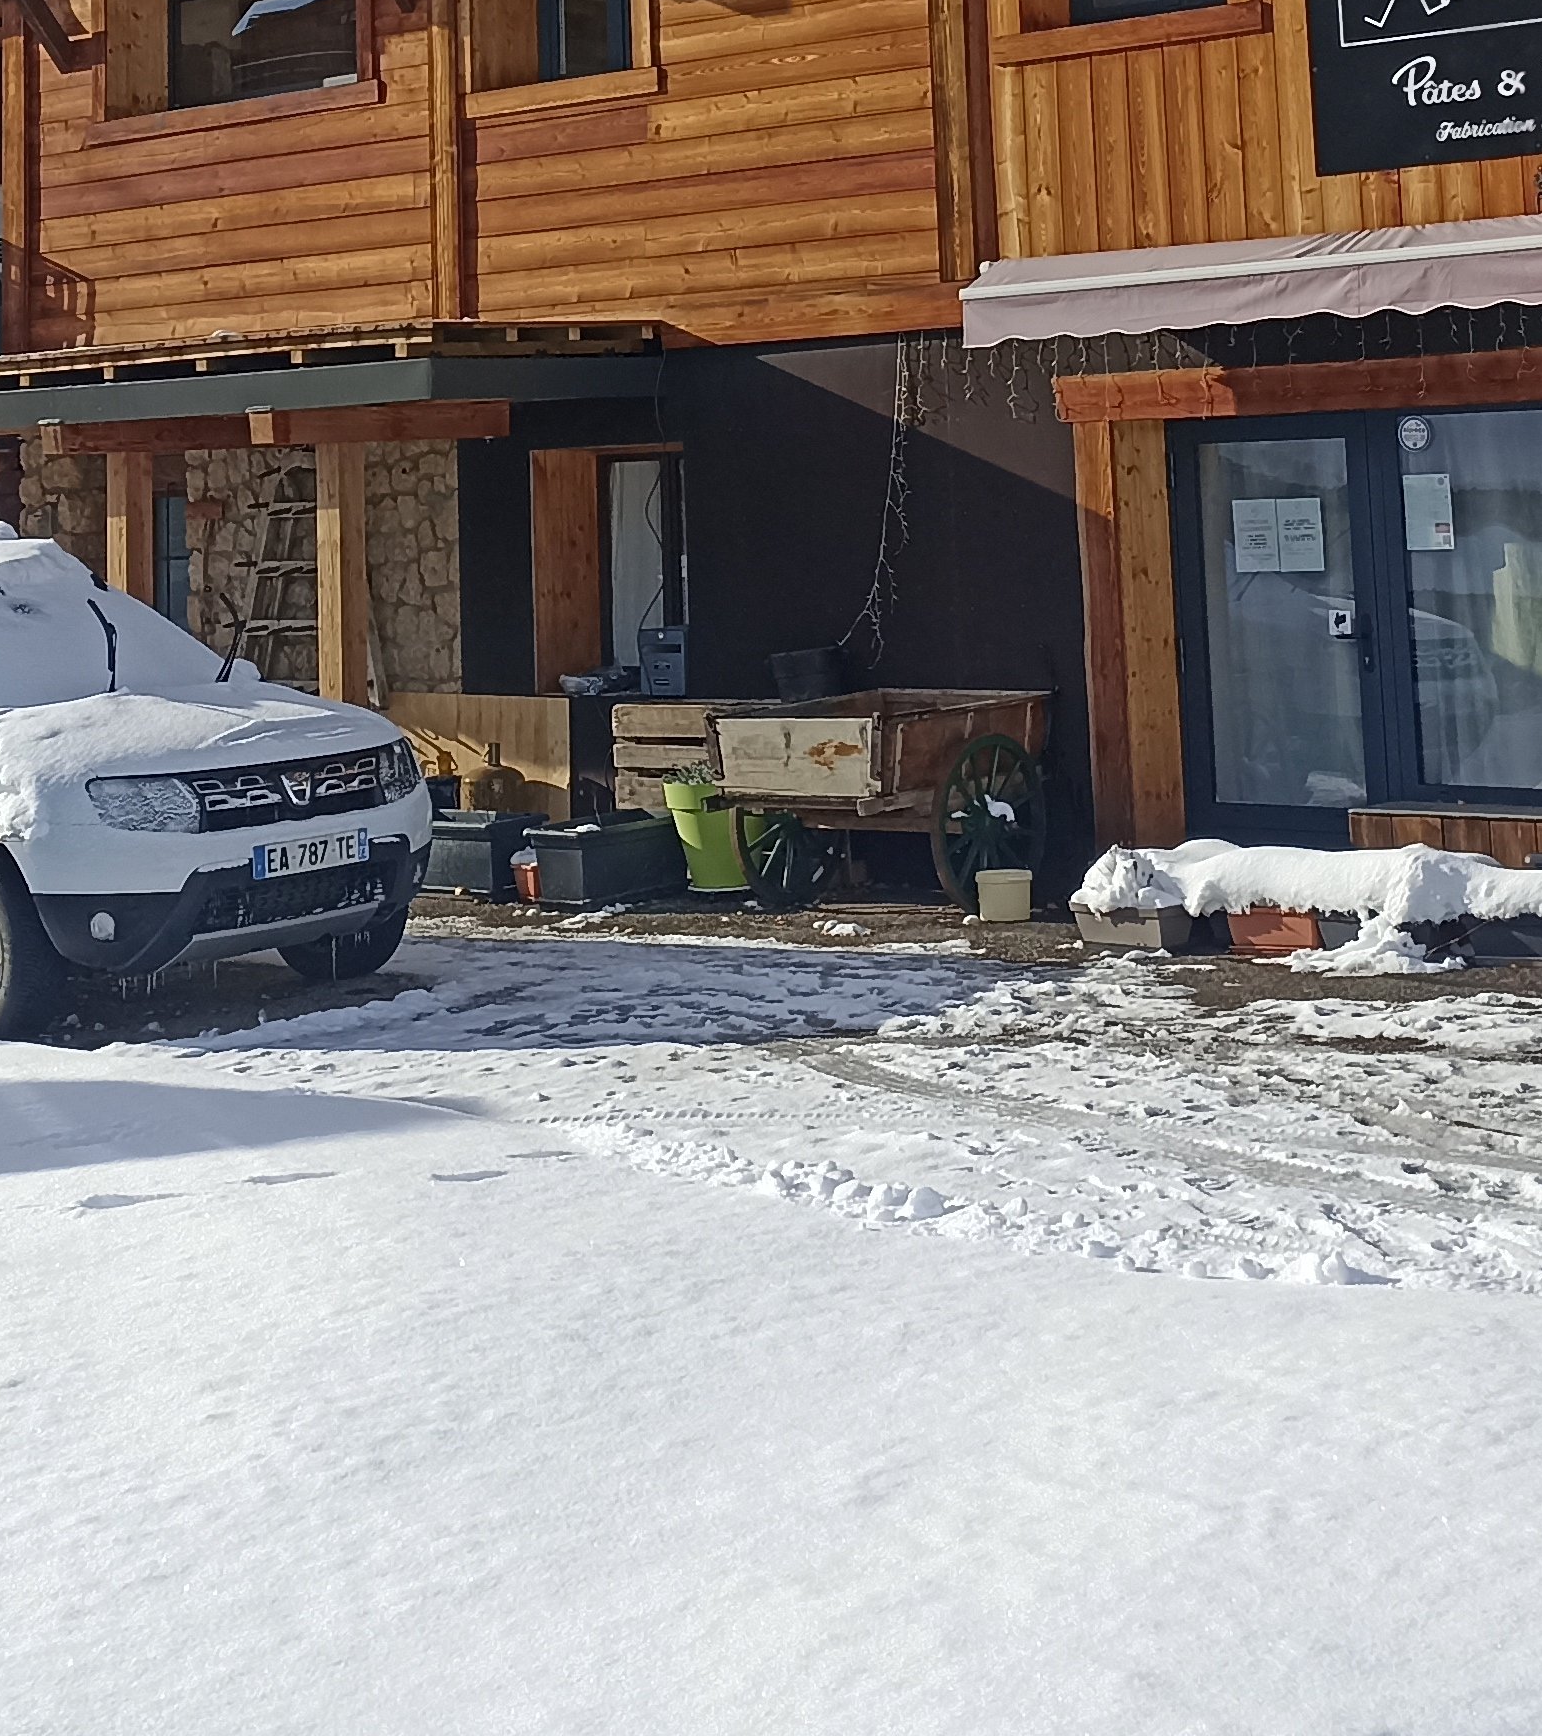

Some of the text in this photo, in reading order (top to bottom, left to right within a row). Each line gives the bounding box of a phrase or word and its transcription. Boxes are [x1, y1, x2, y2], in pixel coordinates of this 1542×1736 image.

[1391, 55, 1482, 106] Pâtes
[1497, 69, 1527, 97] &
[1436, 115, 1537, 142] Fabrication
